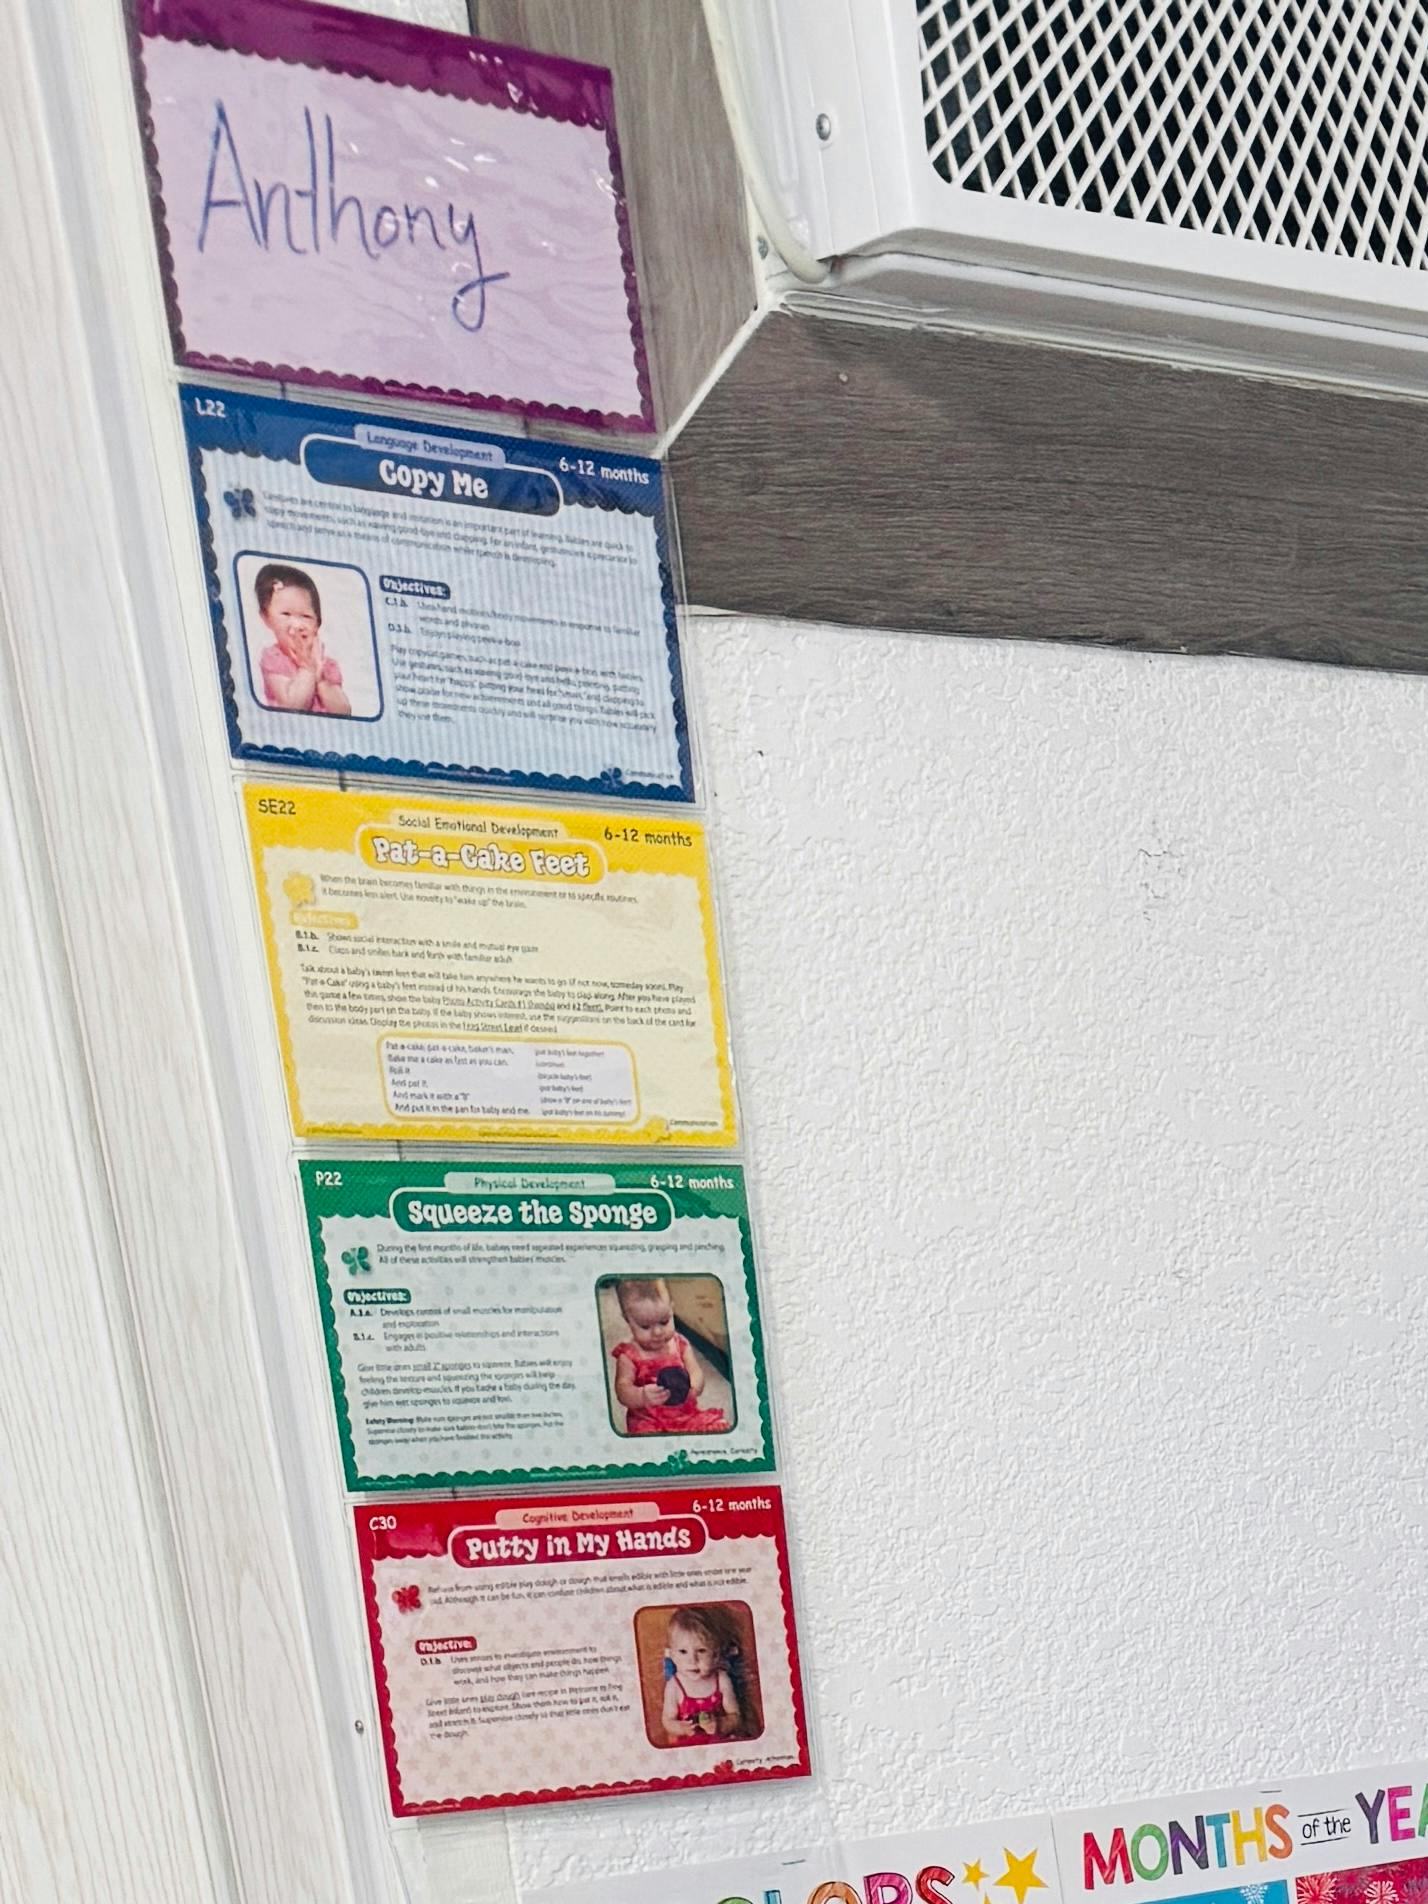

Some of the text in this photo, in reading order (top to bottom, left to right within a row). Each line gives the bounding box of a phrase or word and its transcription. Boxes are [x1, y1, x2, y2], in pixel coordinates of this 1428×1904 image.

[199, 99, 510, 331] Anthony
[366, 430, 496, 465] Language Development
[379, 459, 489, 499] Copy Me
[559, 457, 650, 486] 6-12 months
[257, 799, 297, 816] SE22
[398, 815, 559, 841] Social Emotional Development
[604, 828, 693, 848] 6-12 months
[372, 836, 590, 878] Pat-a-Cake Feet
[315, 1171, 343, 1187] P22
[473, 1175, 586, 1191] Physical Development
[650, 1174, 735, 1190] 6-12 months
[408, 1200, 658, 1230] Squeeze the Sponge
[522, 1506, 634, 1527] Cognitive Development
[692, 1496, 772, 1514] 6-12 months
[368, 1516, 398, 1531] C30
[466, 1526, 692, 1566] Putty in My Hands
[1083, 1803, 1294, 1890] MONTHS
[1301, 1816, 1322, 1840] of
[1323, 1813, 1352, 1837] the
